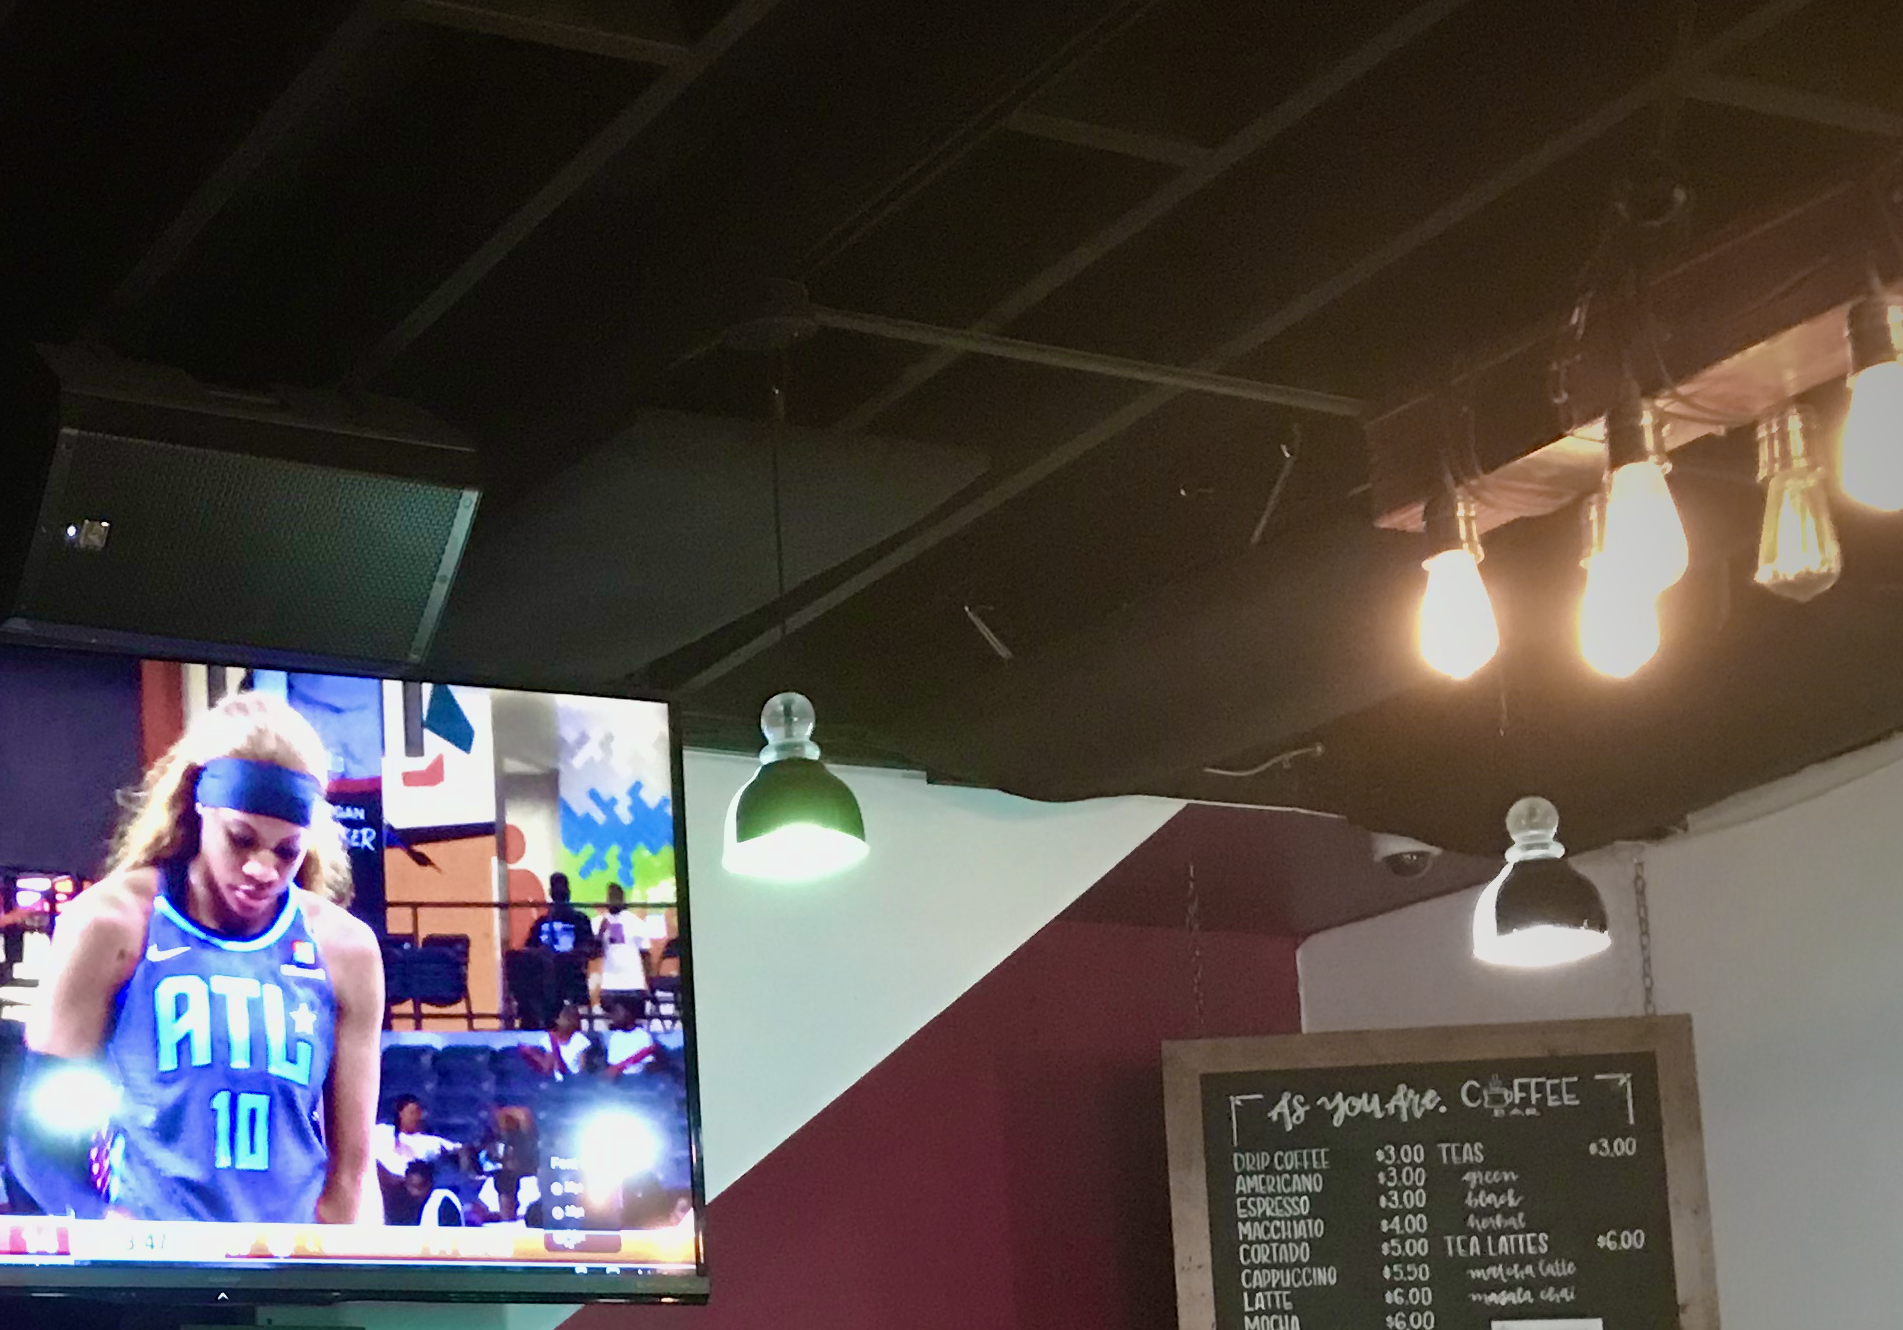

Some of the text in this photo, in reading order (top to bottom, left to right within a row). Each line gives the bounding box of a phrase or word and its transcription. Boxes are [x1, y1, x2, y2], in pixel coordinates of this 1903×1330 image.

[155, 974, 313, 1086] ATL
[1268, 1090, 1311, 1132] As
[210, 1090, 271, 1171] 10
[1233, 1143, 1425, 1173] DRIP COFFEE $3.00
[1437, 1136, 1637, 1165] TEAS $3.00
[1235, 1166, 1427, 1195] AMERICANO $3.00
[1461, 1170, 1520, 1190] green
[1236, 1188, 1427, 1218] ESPRESSO $3.00
[1464, 1187, 1524, 1209] black
[1237, 1213, 1428, 1241] MACCHIATO $4.00
[1466, 1212, 1527, 1233] herbal
[1239, 1237, 1429, 1265] CORTADO $5.00
[1443, 1229, 1646, 1258] TEA LATTES $6.00
[1241, 1263, 1430, 1289] CAPPUCCINO $5.50
[1466, 1258, 1577, 1283] matcha latte
[1243, 1286, 1433, 1312] LATTE $6.00
[1468, 1285, 1577, 1306] masala chai
